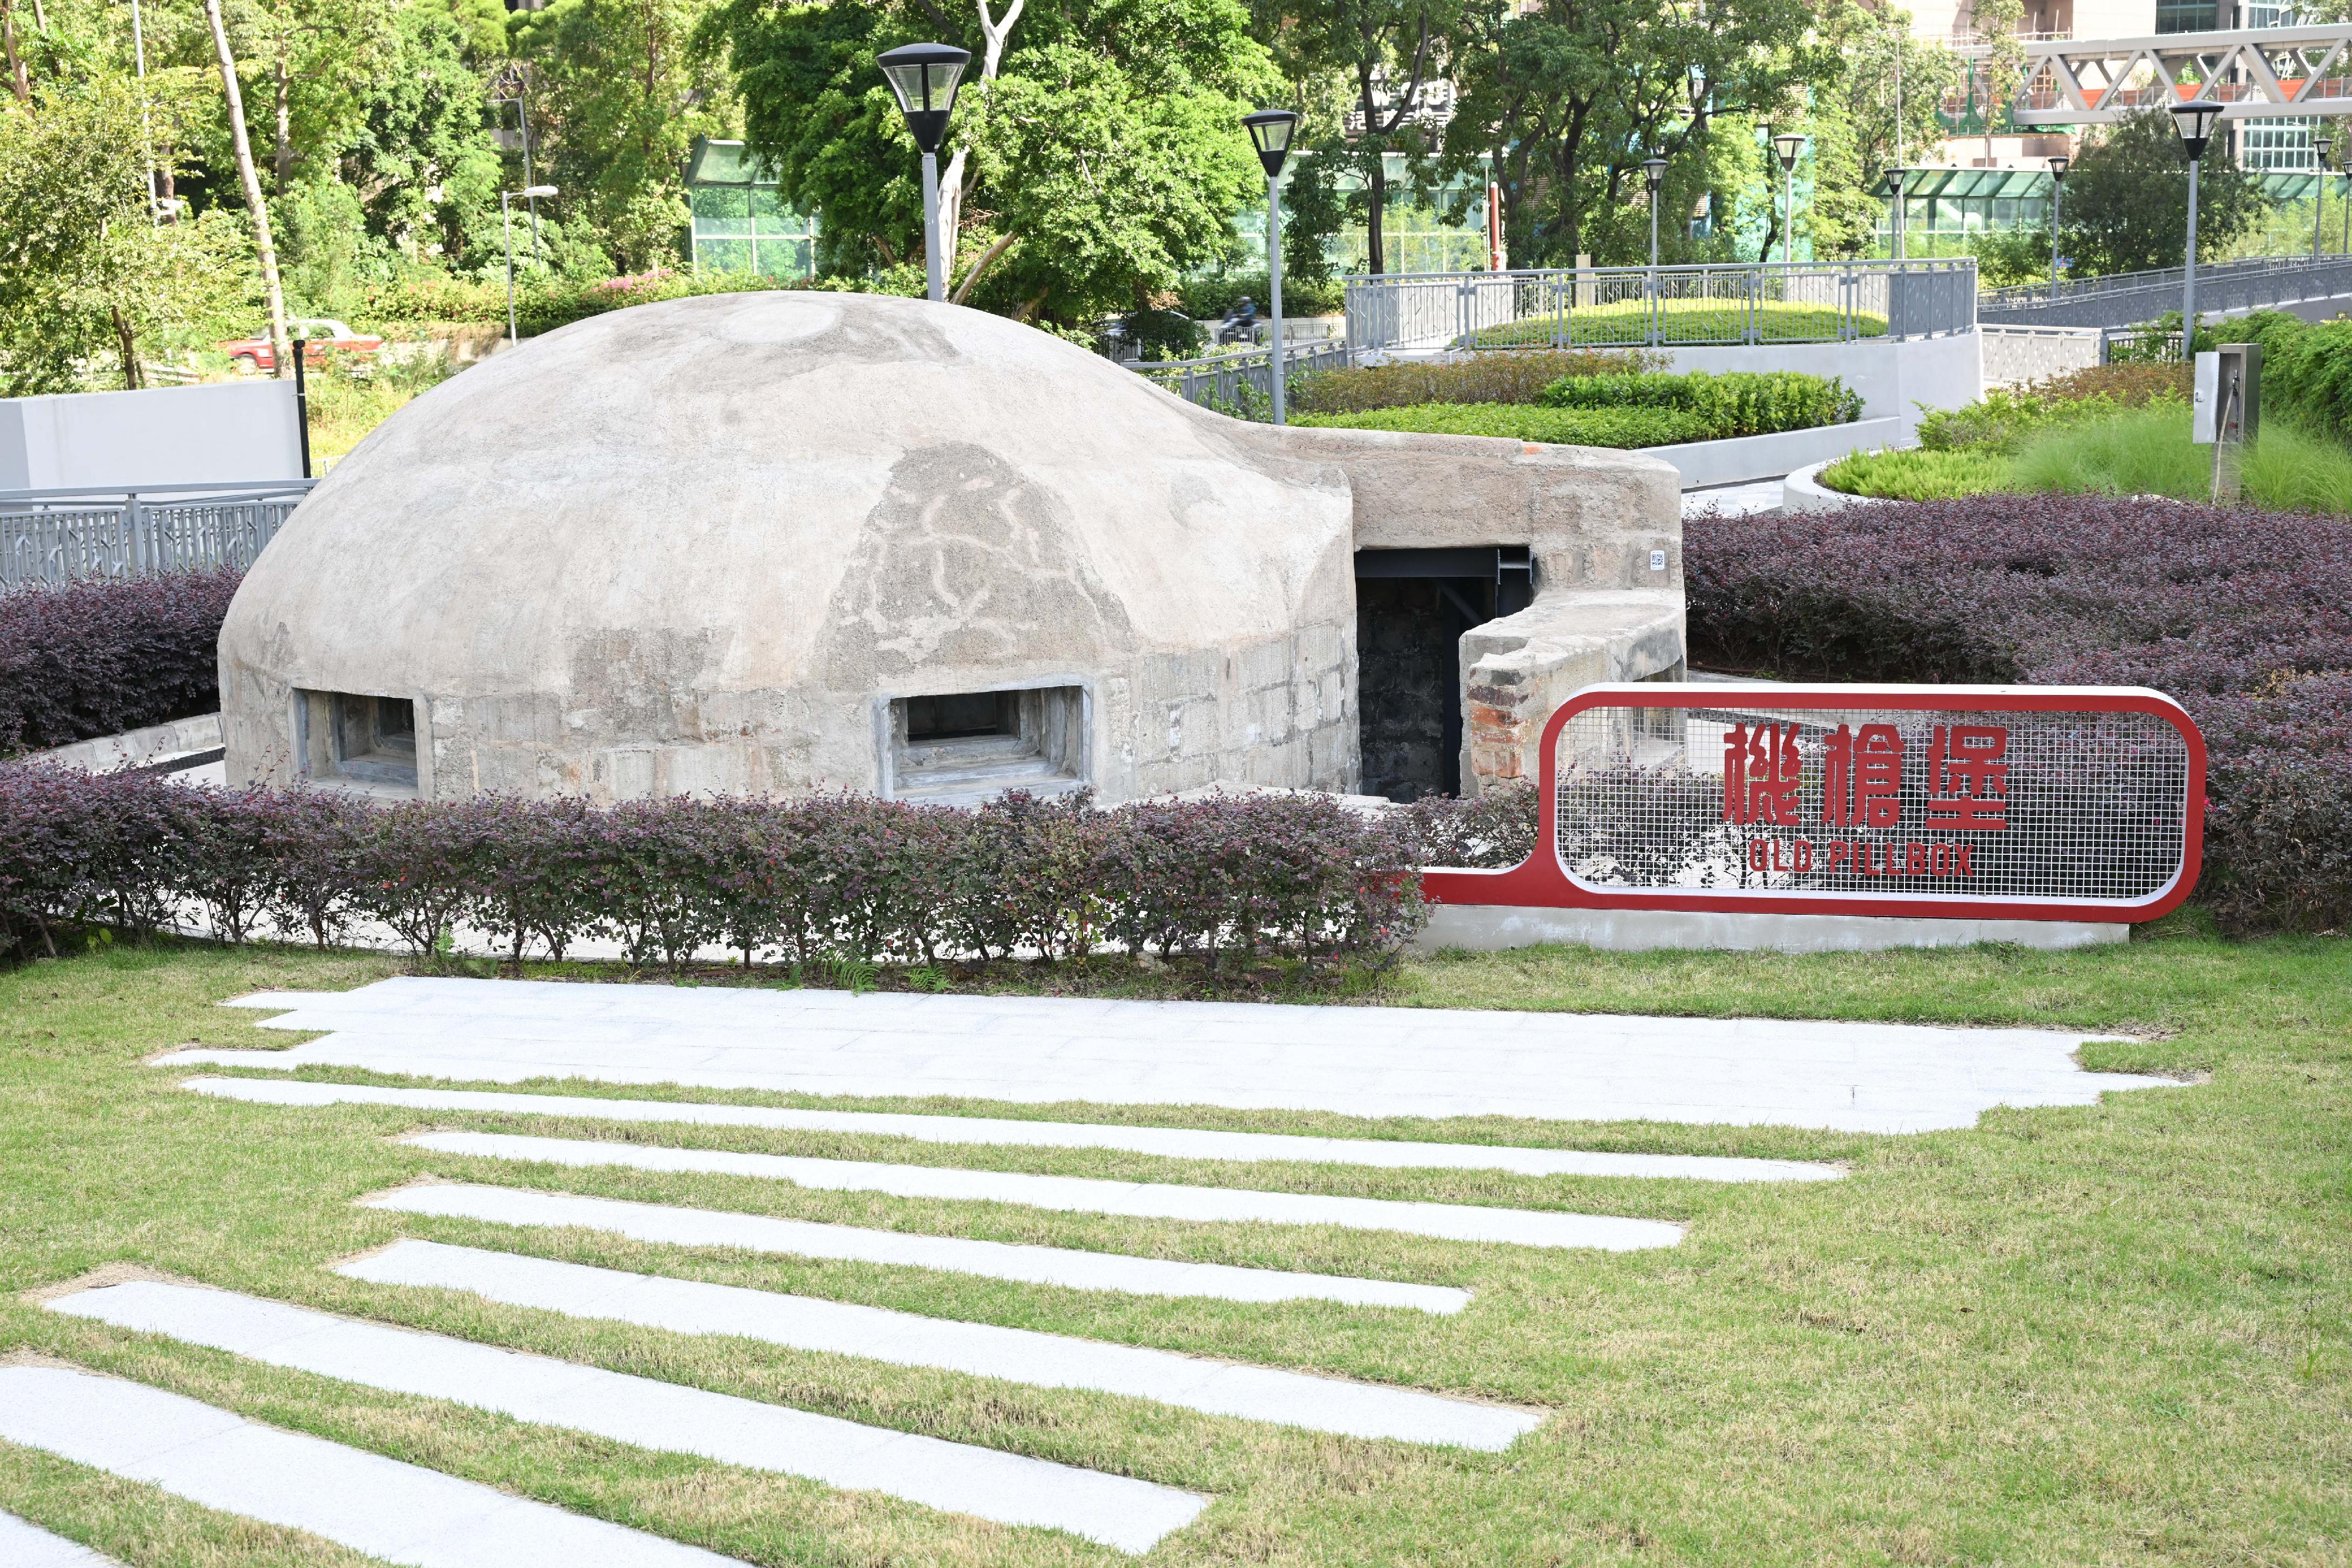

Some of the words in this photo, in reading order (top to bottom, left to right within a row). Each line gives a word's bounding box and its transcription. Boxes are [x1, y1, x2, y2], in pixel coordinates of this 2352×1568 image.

[1722, 722, 2007, 830] 機槍堡
[1749, 838, 1812, 872] OLD
[1829, 840, 1975, 877] PILLBOX
